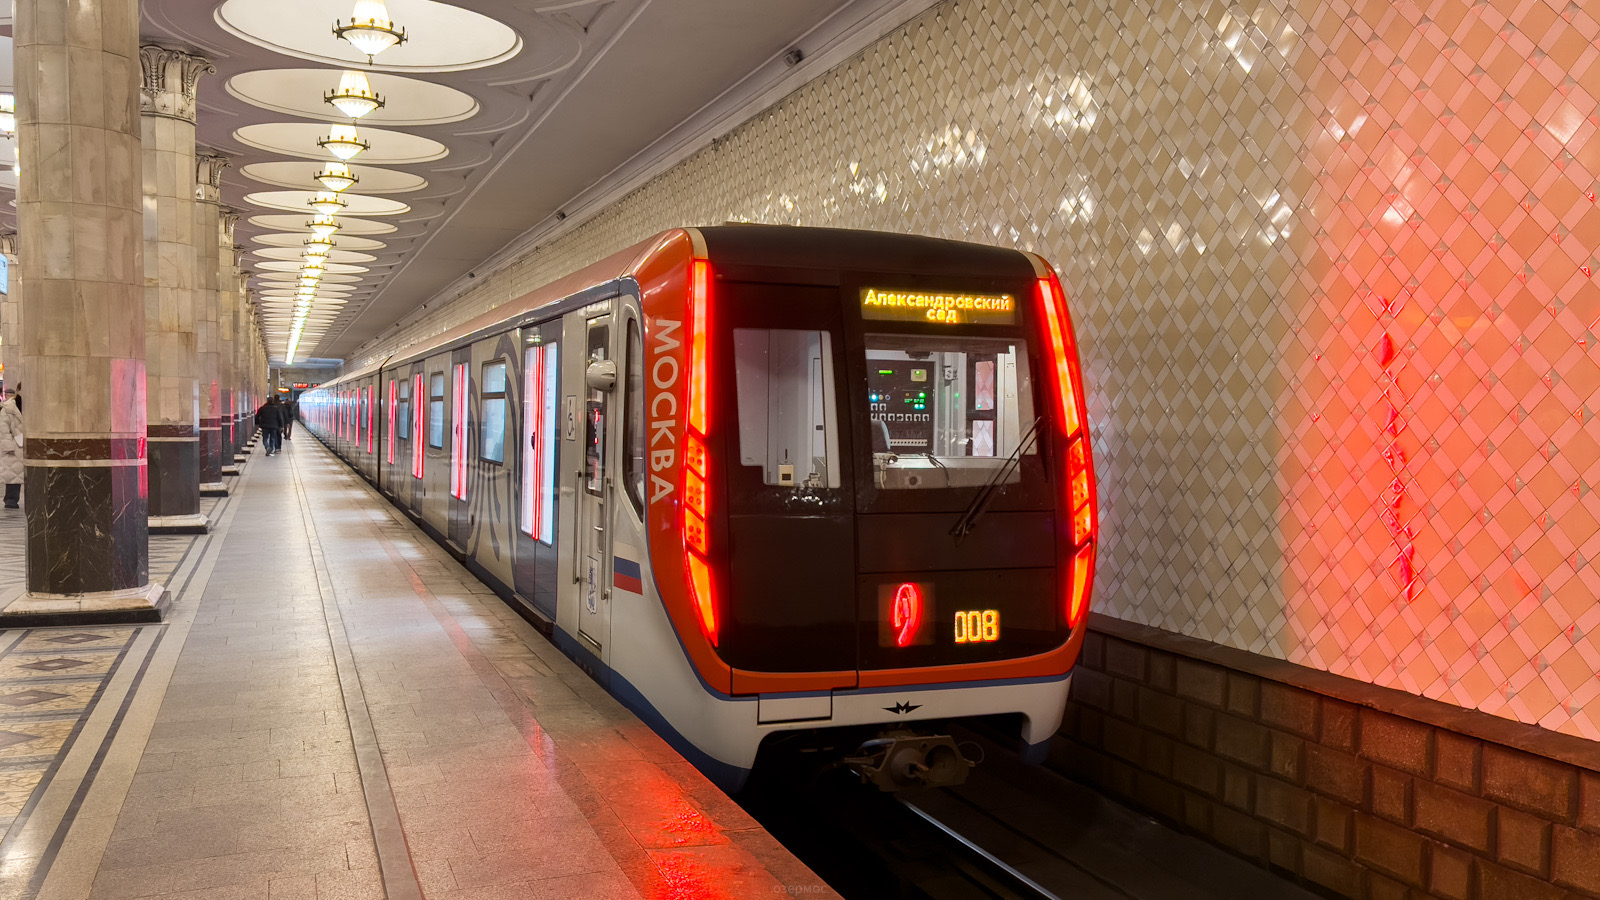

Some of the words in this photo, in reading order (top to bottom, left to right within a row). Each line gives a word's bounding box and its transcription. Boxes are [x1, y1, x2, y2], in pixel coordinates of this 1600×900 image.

[864, 289, 1010, 310] Александровский
[926, 309, 957, 324] сад
[650, 319, 682, 505] МОСКВА
[954, 610, 999, 643] 008
